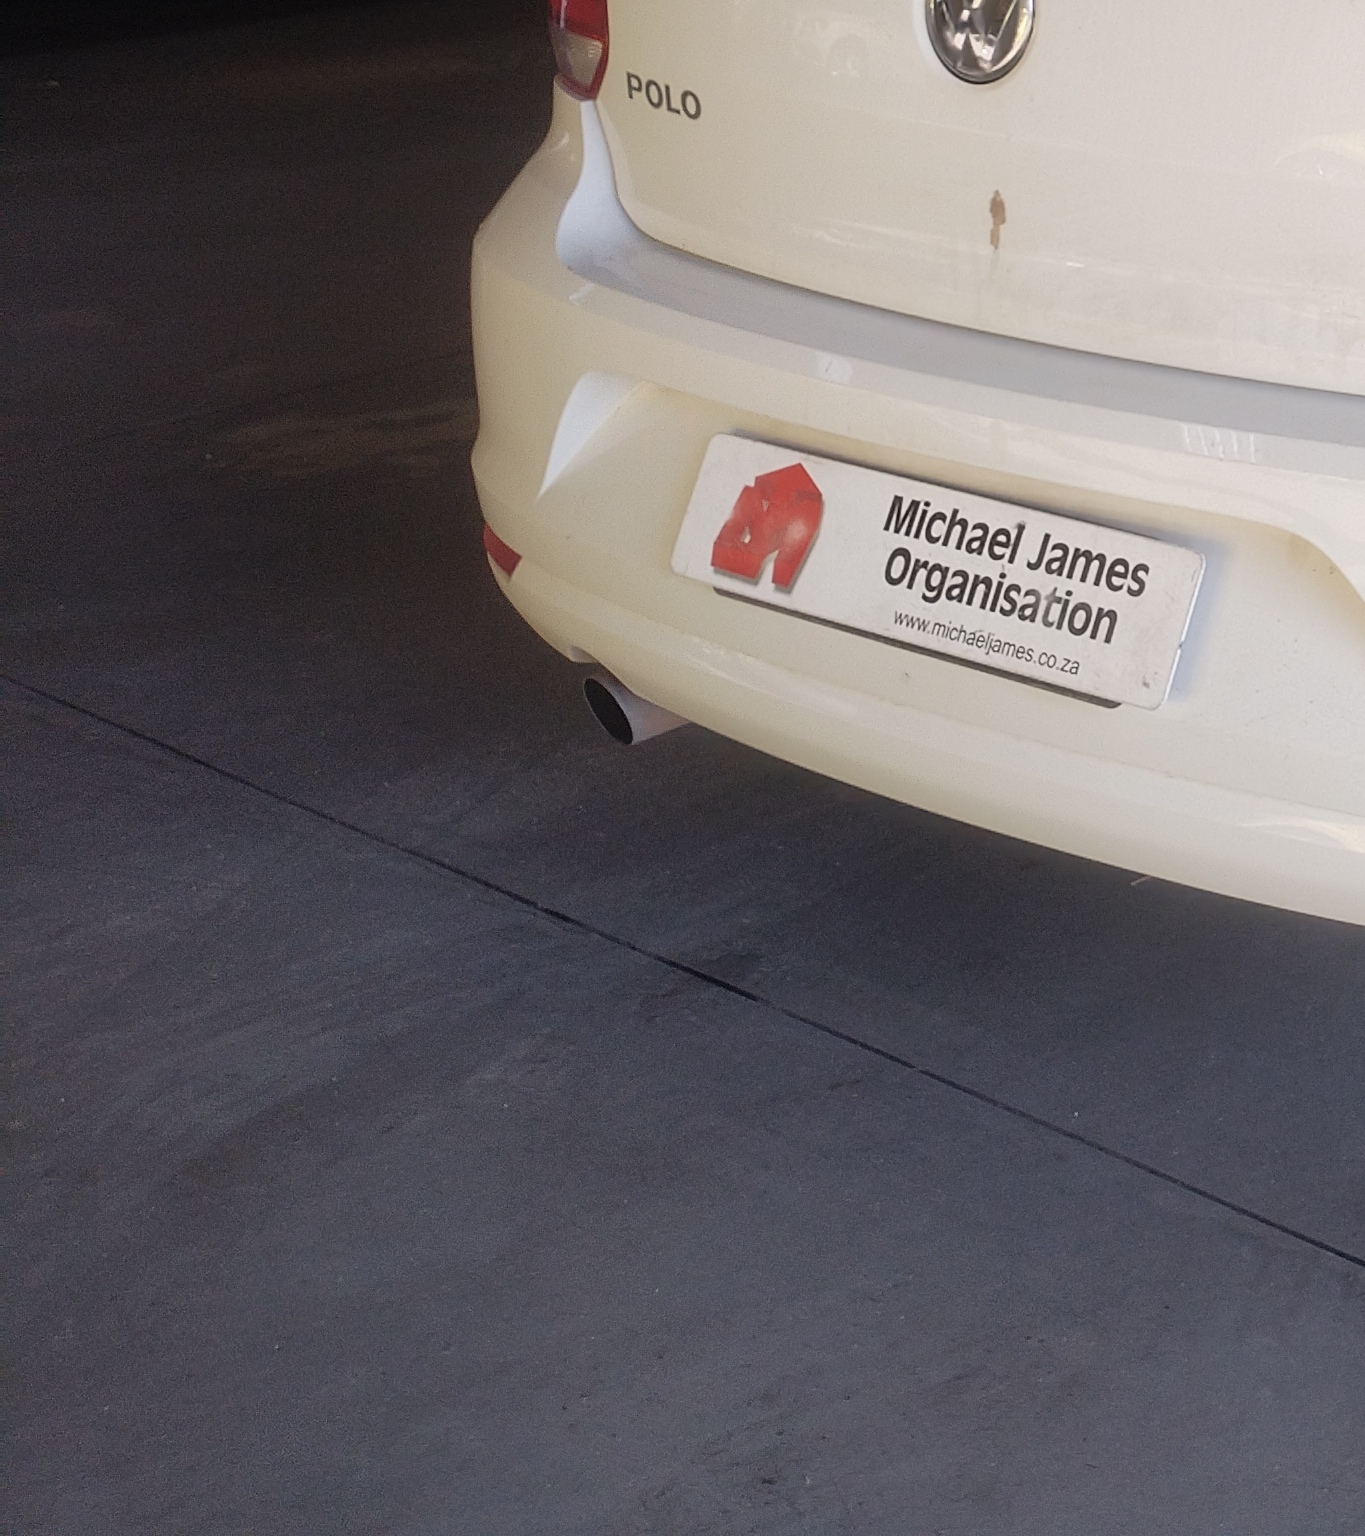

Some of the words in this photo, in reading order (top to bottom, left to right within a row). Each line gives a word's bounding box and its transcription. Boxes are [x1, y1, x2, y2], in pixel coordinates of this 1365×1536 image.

[625, 71, 702, 121] POLO
[883, 495, 1026, 565] Michael
[1027, 533, 1150, 598] James
[885, 547, 1117, 645] Organisation
[893, 609, 1080, 676] www.michaeljames.co.za
